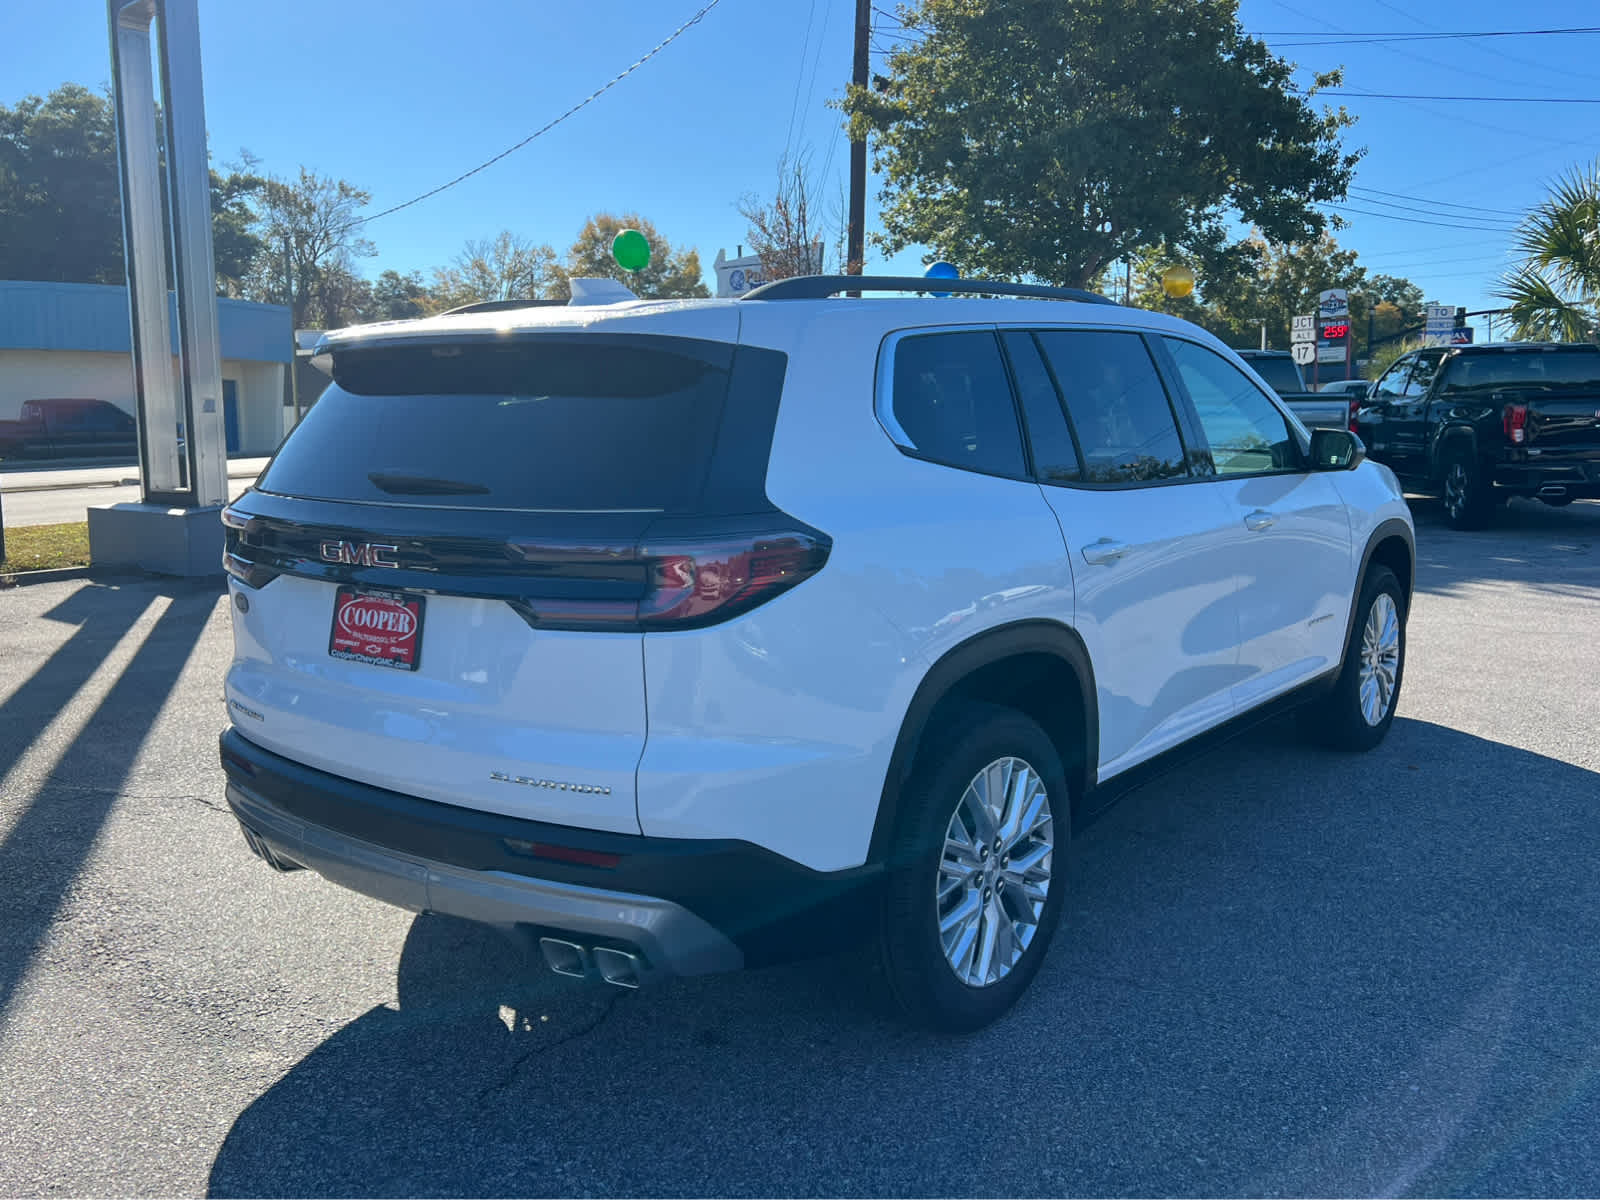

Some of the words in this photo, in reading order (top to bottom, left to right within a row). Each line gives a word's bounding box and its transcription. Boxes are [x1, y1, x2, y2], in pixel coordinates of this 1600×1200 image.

[1433, 308, 1448, 317] TO
[1293, 317, 1313, 329] JCT
[1296, 331, 1311, 340] ALT
[1297, 347, 1309, 360] 17
[320, 540, 399, 569] GMC
[344, 606, 410, 633] COOPER
[489, 771, 611, 795] ELEVATION
